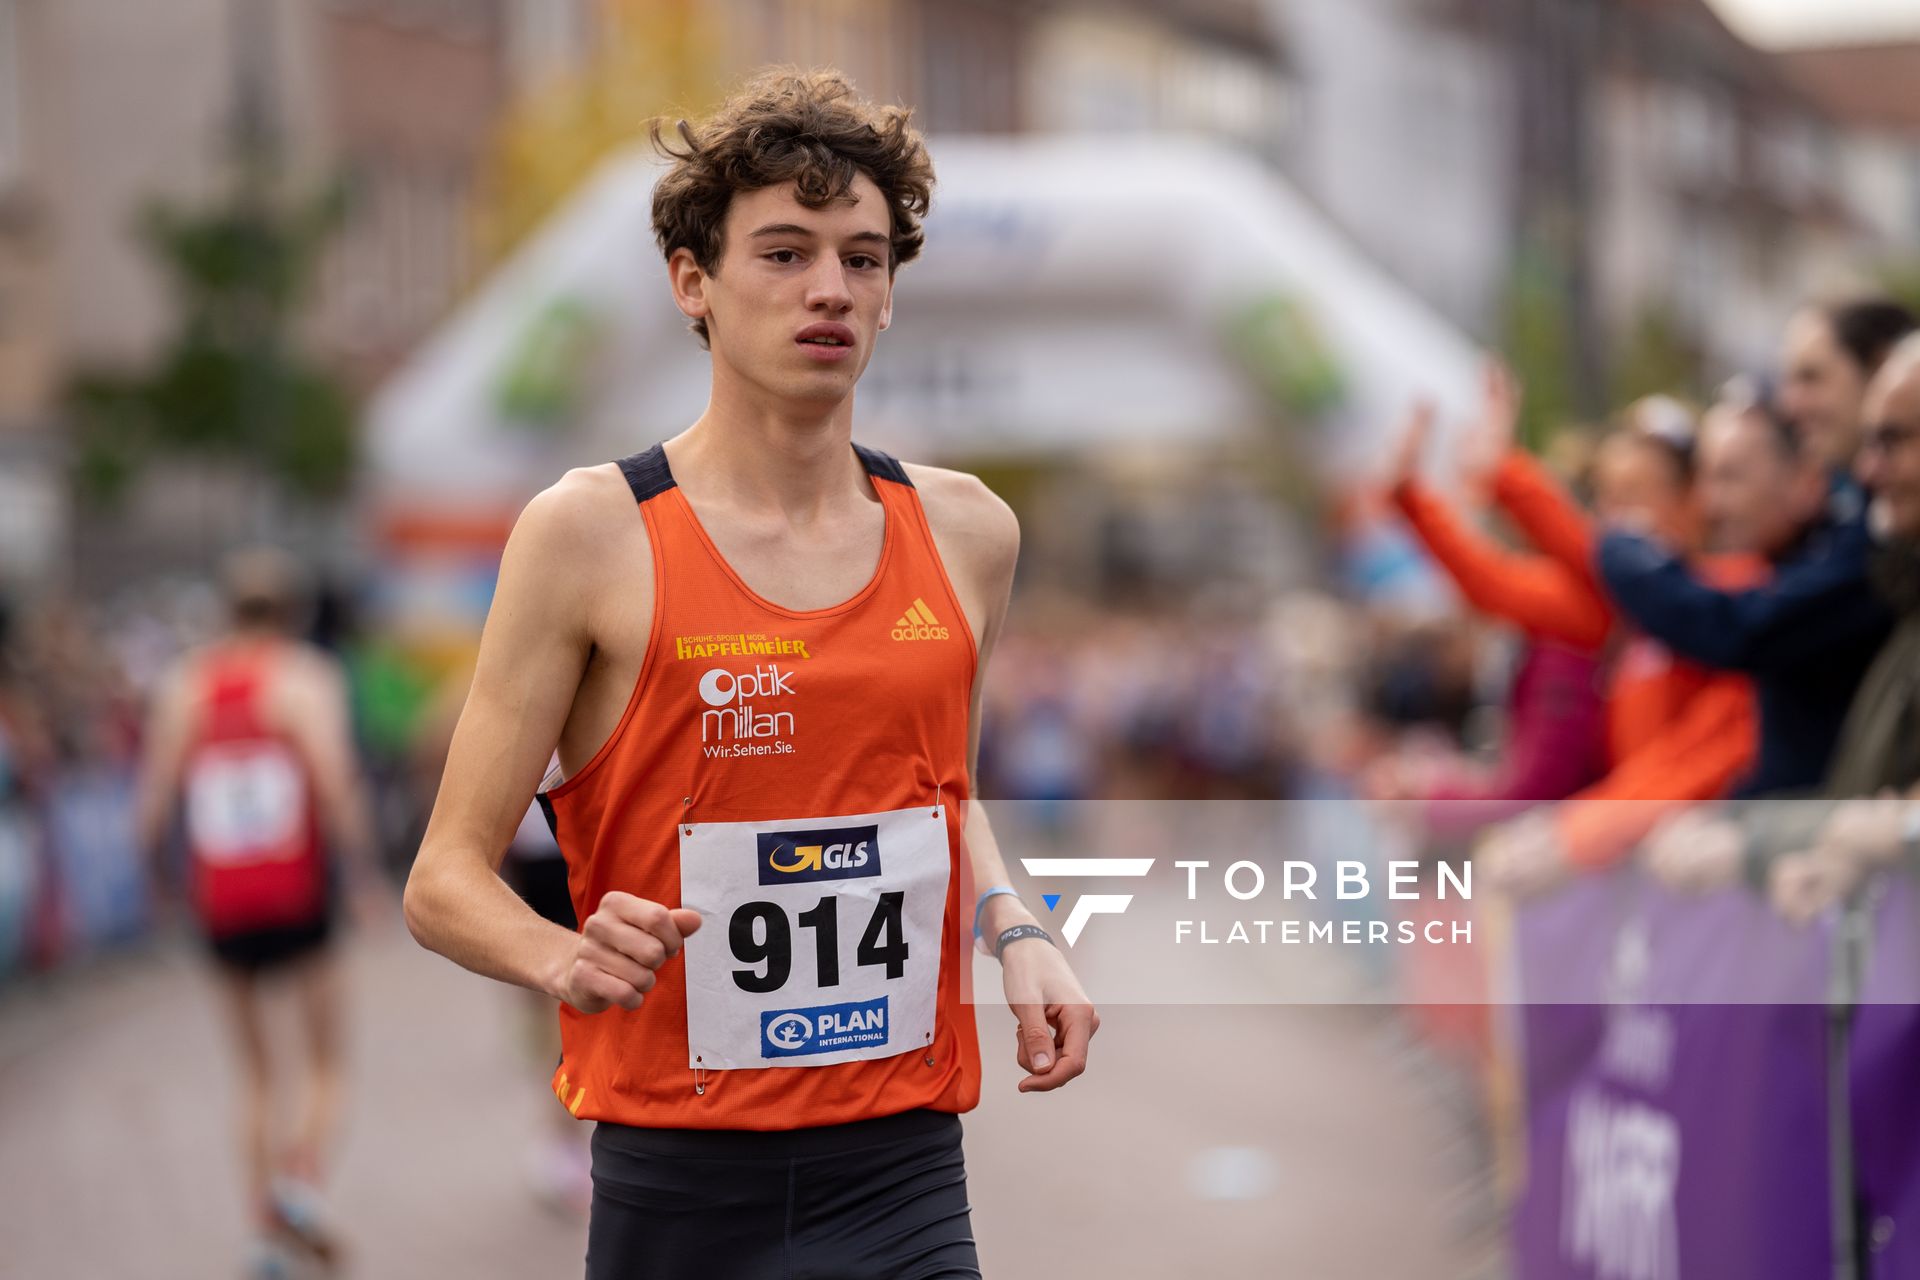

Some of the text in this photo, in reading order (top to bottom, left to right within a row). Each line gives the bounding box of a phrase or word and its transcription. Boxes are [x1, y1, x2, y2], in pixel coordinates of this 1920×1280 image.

[746, 633, 767, 641] MODE
[891, 624, 950, 641] adidas
[698, 664, 796, 706] Optik
[702, 705, 795, 742] millan
[704, 741, 796, 759] Wir.Sehen.Sie.
[823, 841, 868, 869] GLS
[728, 891, 909, 993] 914
[818, 1008, 884, 1036] PLAN
[819, 1032, 884, 1047] INTERNATIONAL
